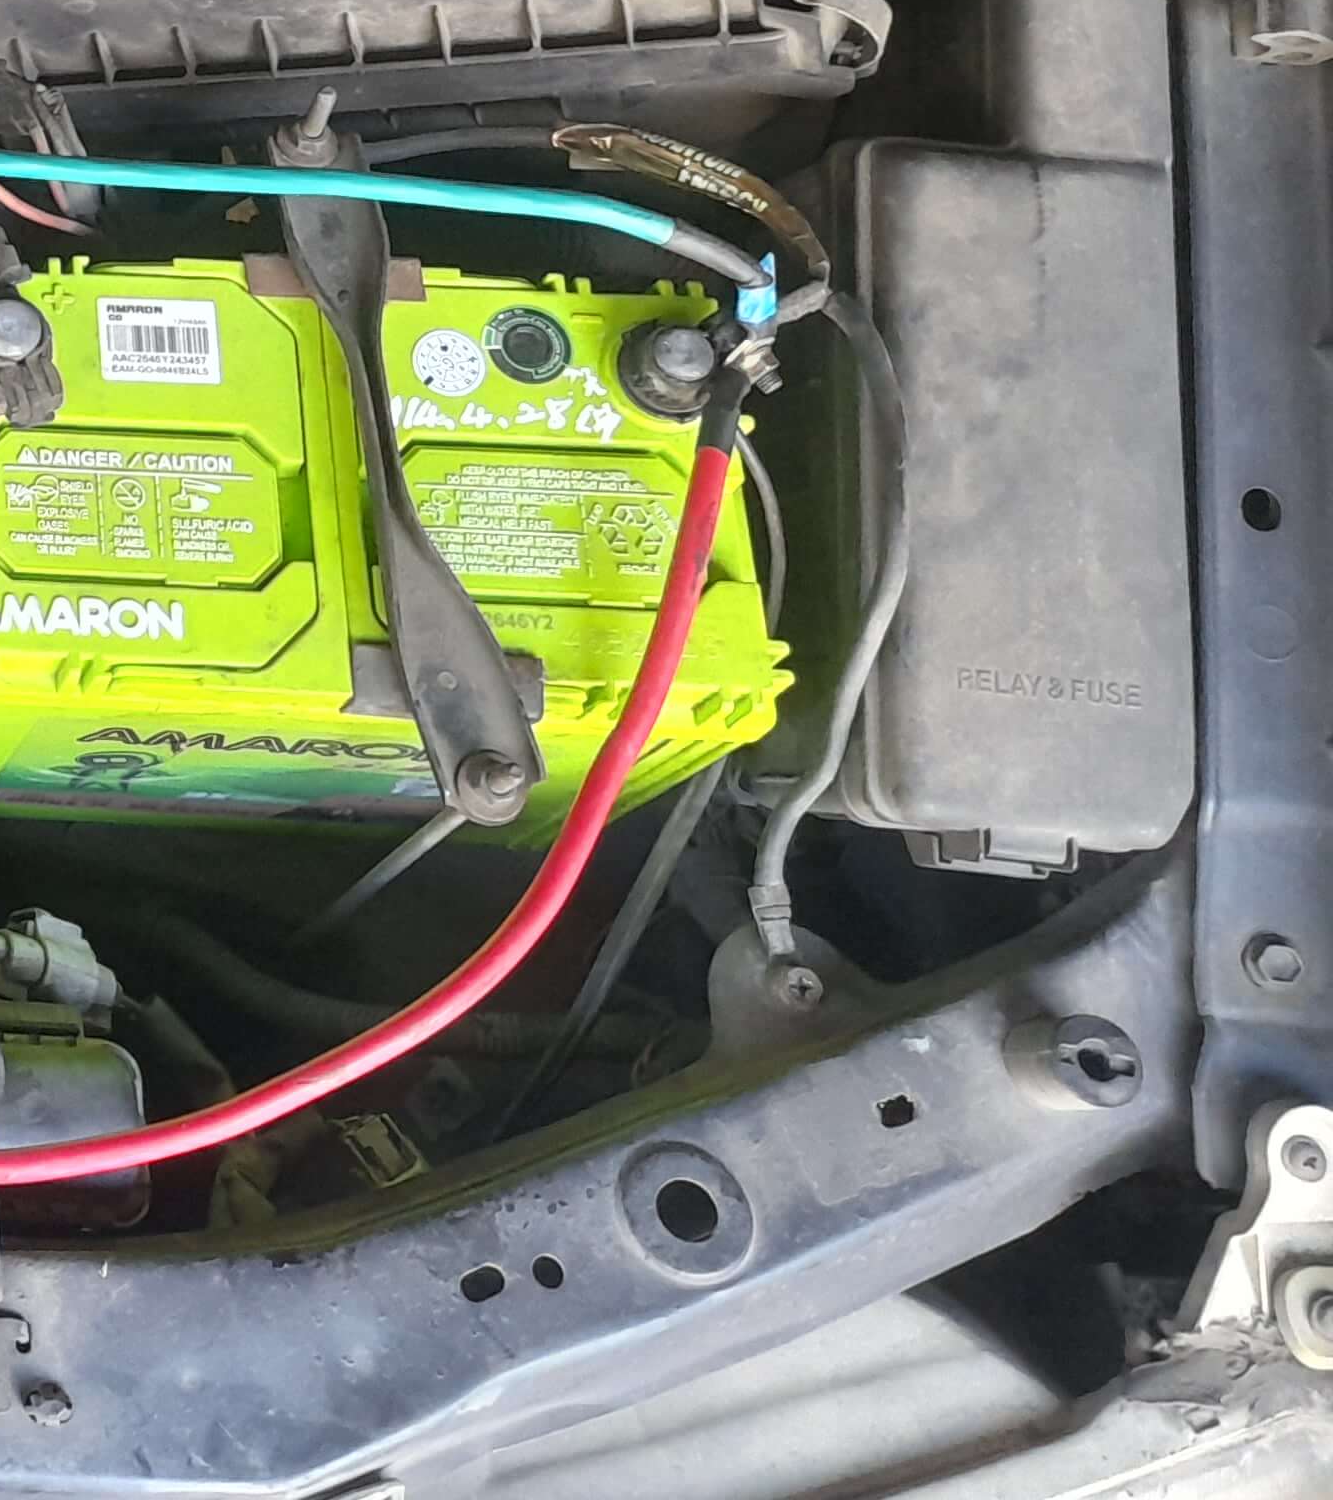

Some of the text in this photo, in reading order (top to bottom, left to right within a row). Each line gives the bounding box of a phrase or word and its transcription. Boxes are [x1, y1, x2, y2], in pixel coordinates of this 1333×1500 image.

[106, 304, 163, 314] AMARON
[38, 447, 123, 468] DANGER
[143, 453, 232, 473] CAUTION
[59, 480, 93, 493] SHIELD
[37, 506, 89, 520] EXPLOSIVE
[37, 520, 70, 533] GASES
[172, 517, 254, 533] SULFURIC ACID
[957, 668, 1142, 708] RELAY & FUSE
